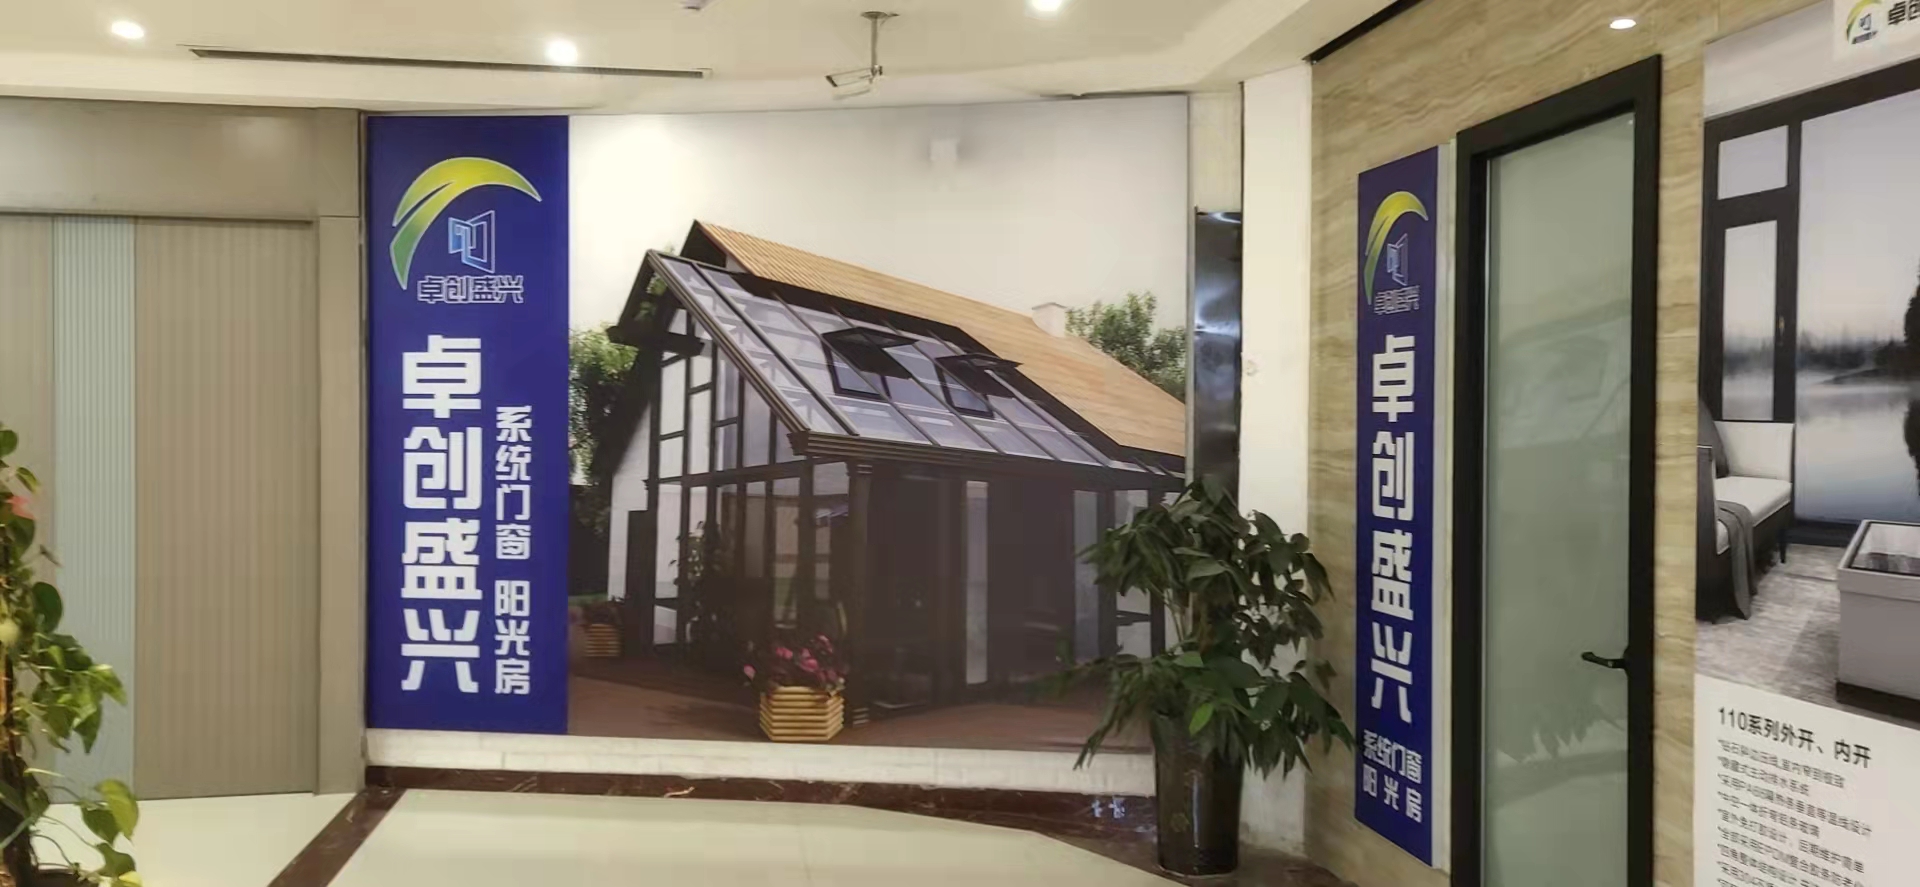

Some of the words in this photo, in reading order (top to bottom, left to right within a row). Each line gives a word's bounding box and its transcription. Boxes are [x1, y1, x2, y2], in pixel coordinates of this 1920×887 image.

[417, 275, 524, 303] 卓创盛兴
[401, 334, 482, 694] 卓创盛兴
[495, 405, 532, 561] 系统门窗
[1371, 334, 1415, 724] 卓创盛兴
[494, 579, 531, 696] 阳光房
[1363, 729, 1422, 784] 系统门窗
[1363, 763, 1422, 823] 阳光房
